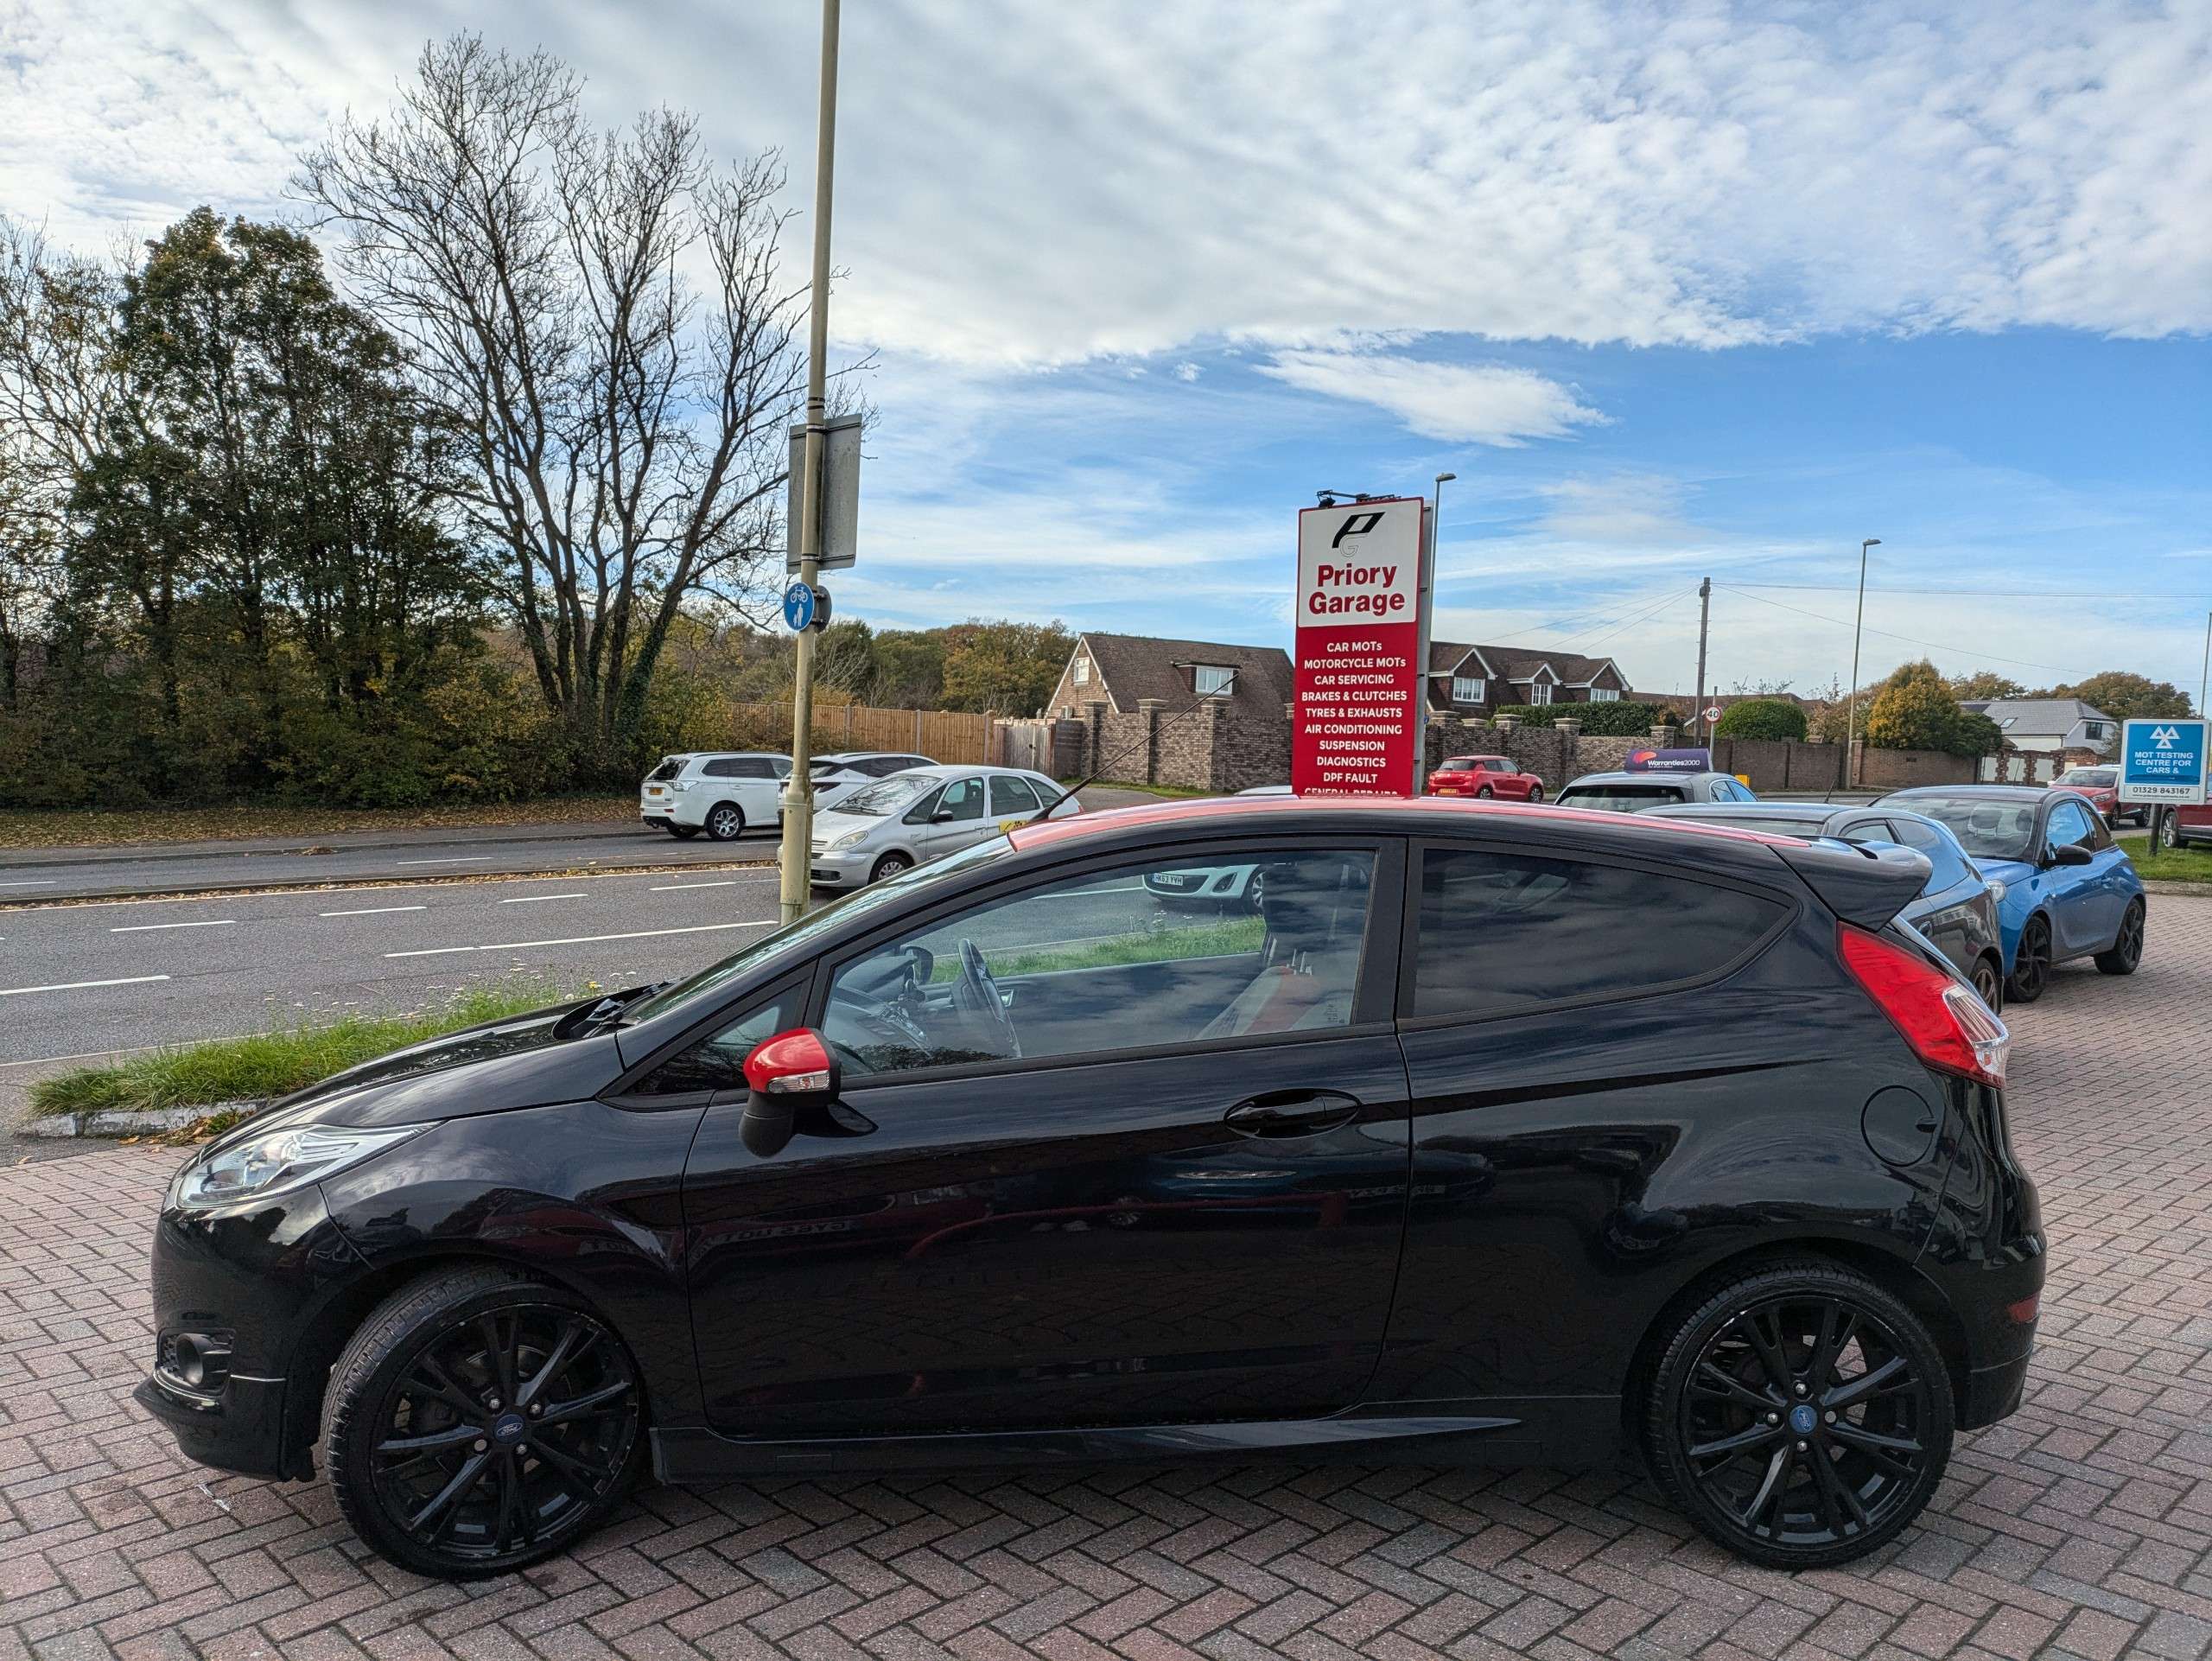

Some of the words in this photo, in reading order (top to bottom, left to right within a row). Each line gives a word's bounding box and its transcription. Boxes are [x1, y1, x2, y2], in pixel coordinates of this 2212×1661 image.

[1318, 563, 1397, 589] Priory
[1309, 592, 1405, 616] Garage
[1326, 642, 1349, 652] CAR
[1351, 641, 1382, 652] MOTs
[1304, 659, 1373, 669] MOTORCYCLE
[1376, 657, 1406, 667] MOTs
[1314, 675, 1335, 685] CAR
[1338, 674, 1394, 684] SERVICING
[1301, 691, 1340, 701] BRAKES
[1343, 691, 1350, 701] &
[1352, 690, 1408, 701] CLUTCHES
[1306, 708, 1336, 717] TYRES
[1338, 708, 1345, 717] &
[1347, 708, 1402, 718] EXHAUSTS
[1305, 724, 1322, 734] AIR
[1324, 724, 1402, 735] CONDITIONING
[1319, 740, 1385, 751] SUSPENSION
[1317, 756, 1386, 767] DIAGNOSTICS
[1323, 772, 1343, 782] DPF
[1345, 773, 1378, 784] FAULT
